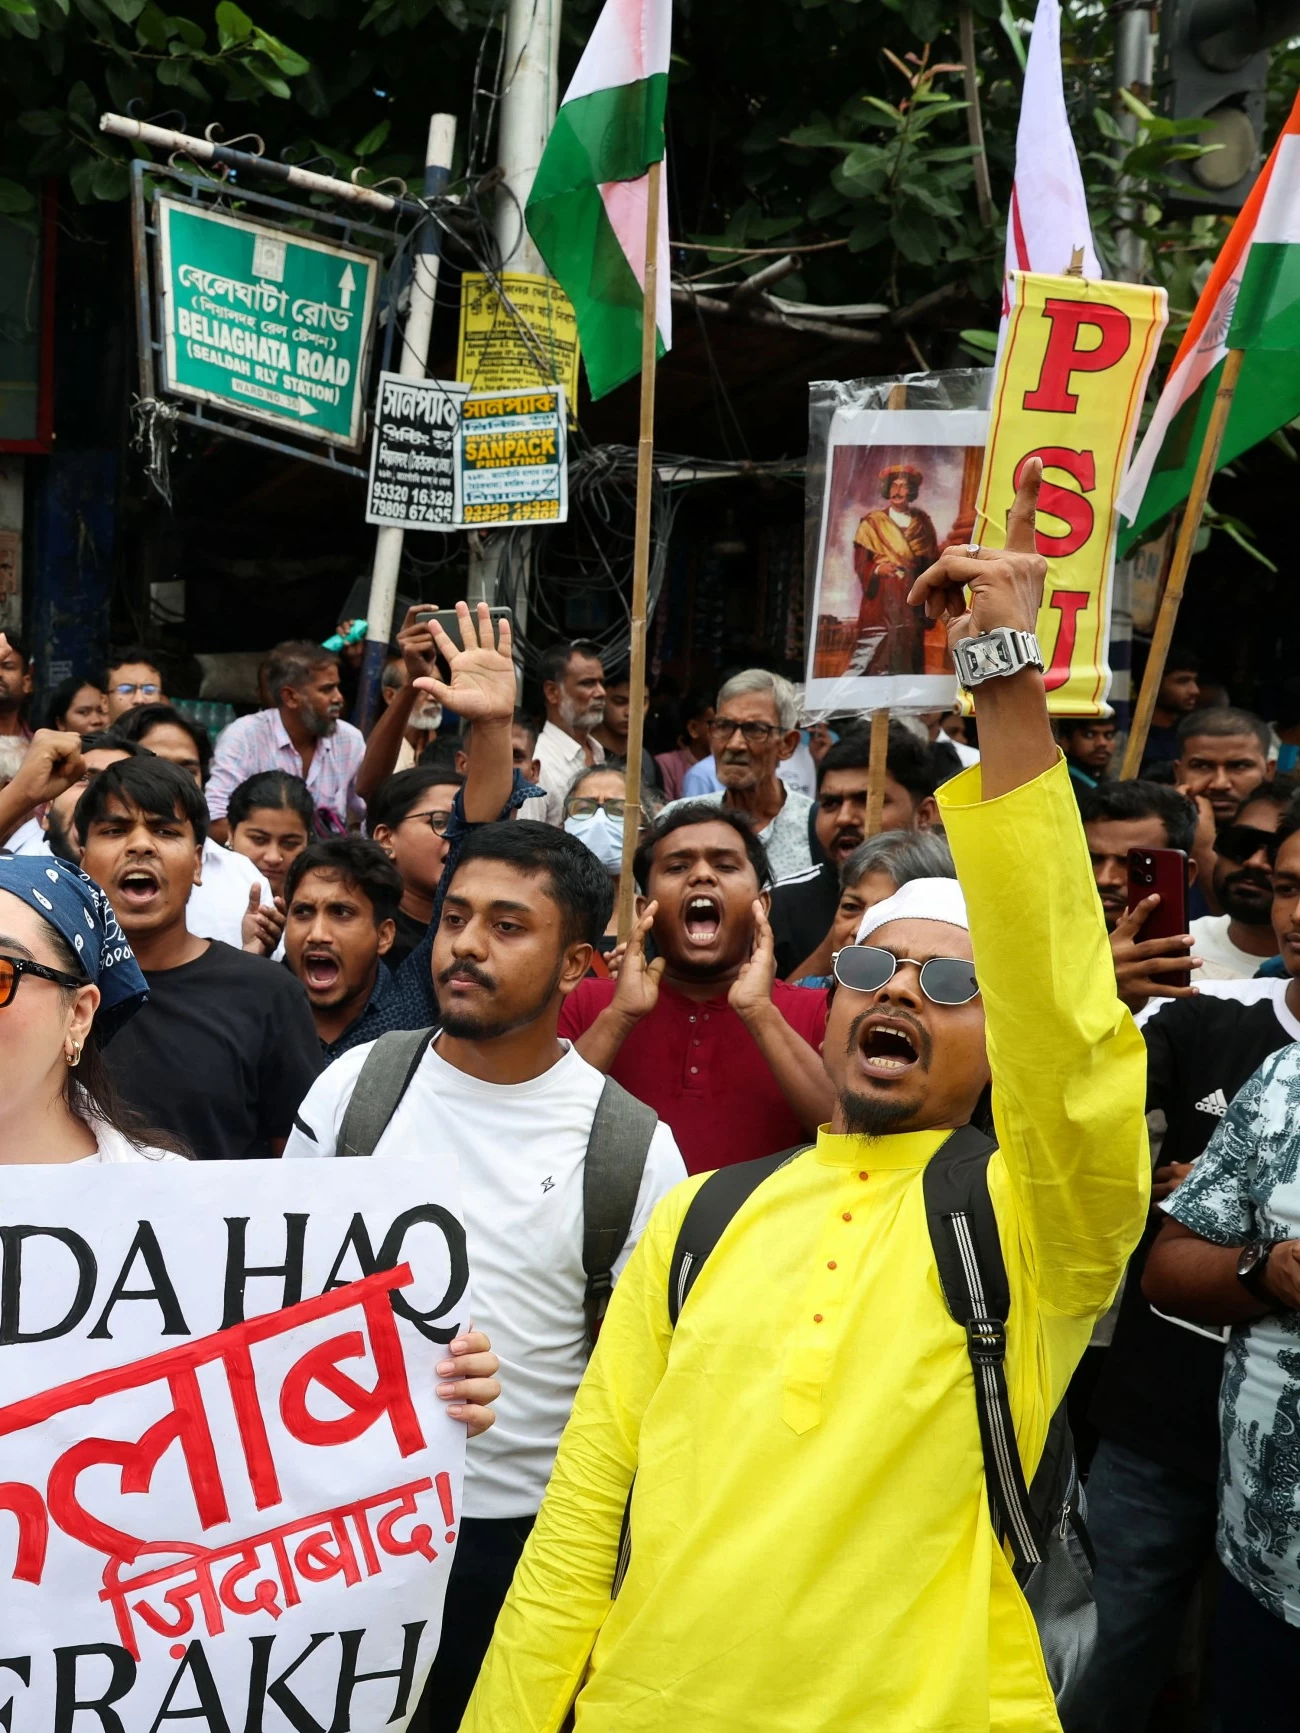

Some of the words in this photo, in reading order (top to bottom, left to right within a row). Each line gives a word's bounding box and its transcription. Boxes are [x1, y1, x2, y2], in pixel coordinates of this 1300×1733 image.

[178, 264, 290, 318] বেলেঘাটা
[292, 299, 354, 331] রোড
[178, 307, 291, 372] BELIAGHATA
[296, 347, 350, 386] ROAD
[186, 340, 250, 377] (SEALDAH
[255, 365, 278, 386] RLY
[282, 375, 340, 406] STATION)
[235, 380, 264, 397] WARD
[465, 433, 503, 444] MULTI
[505, 428, 555, 441] COLOUR
[465, 437, 556, 460] SANPACK
[476, 457, 547, 469] PRINTING
[373, 481, 409, 497] 93320
[411, 488, 454, 507] 16328
[372, 500, 407, 518] 79809
[218, 1203, 469, 1345] HAQ
